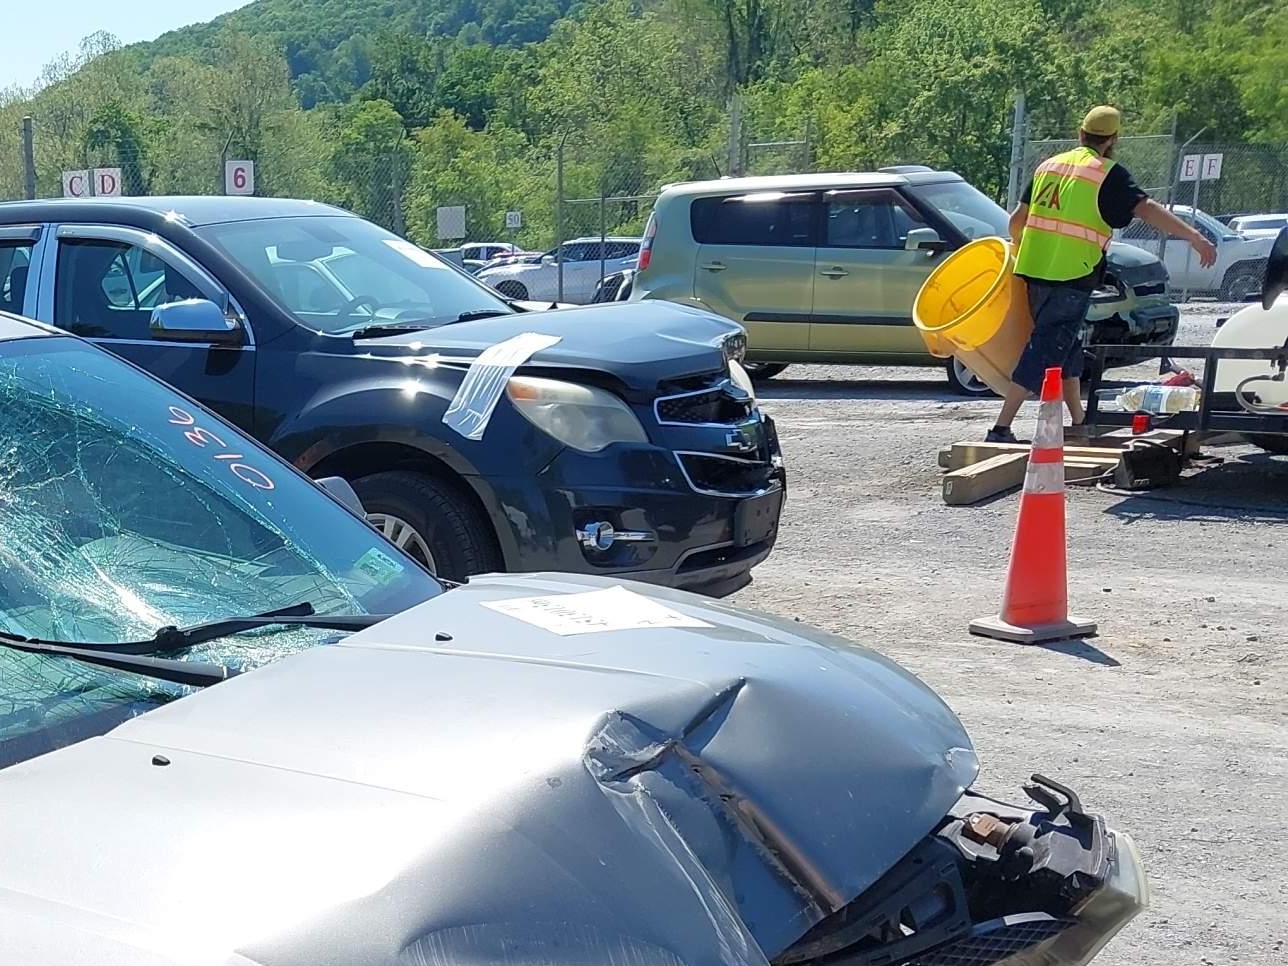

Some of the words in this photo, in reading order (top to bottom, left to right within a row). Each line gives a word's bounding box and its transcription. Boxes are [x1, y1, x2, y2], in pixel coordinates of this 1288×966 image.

[1185, 160, 1195, 177] E
[1208, 158, 1218, 176] F
[69, 175, 83, 197] C
[100, 174, 116, 195] D
[233, 167, 246, 189] 6
[167, 405, 275, 490] 0136
